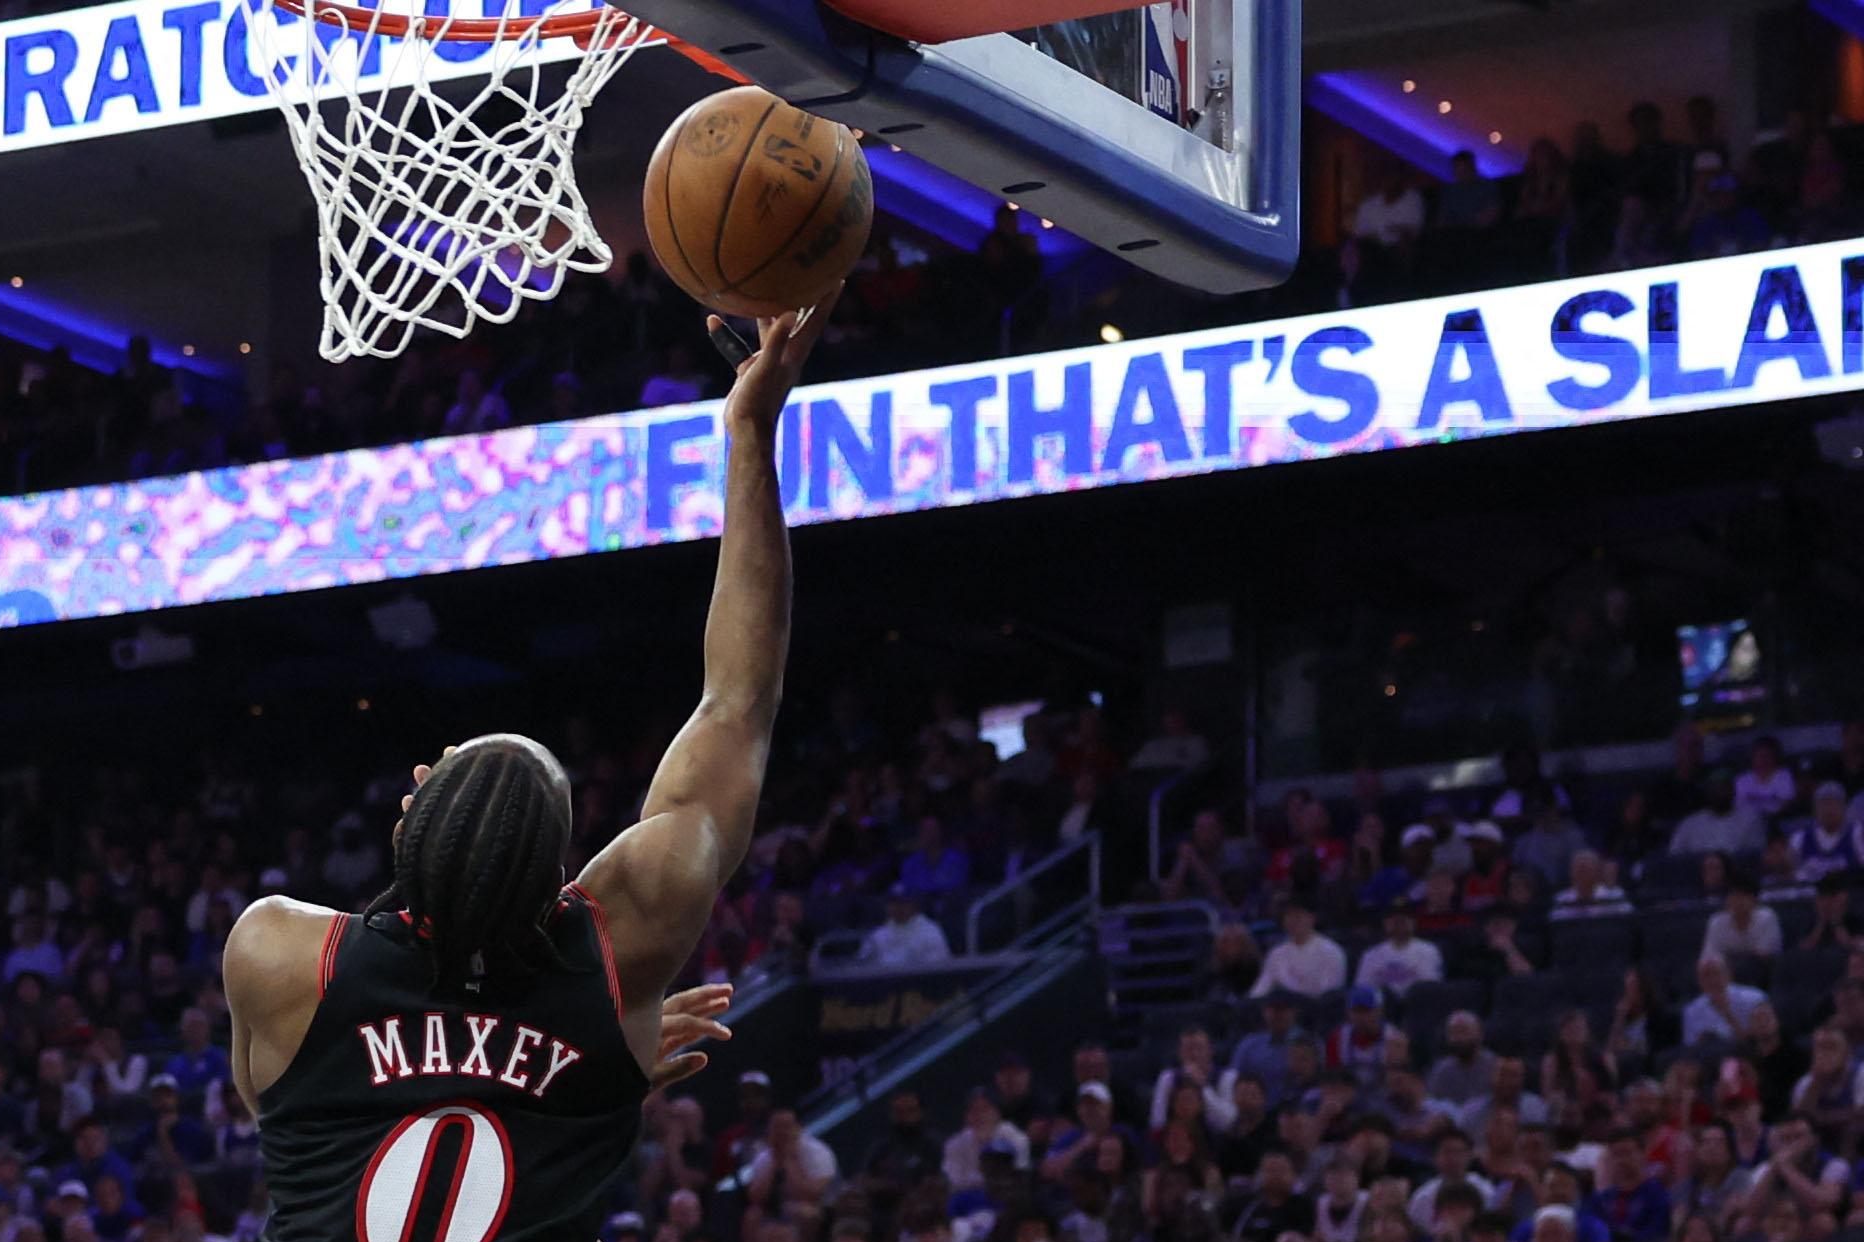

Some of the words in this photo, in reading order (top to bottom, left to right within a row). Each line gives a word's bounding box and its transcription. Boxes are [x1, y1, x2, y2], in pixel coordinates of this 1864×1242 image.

[1149, 69, 1174, 115] NBA
[929, 327, 1382, 493] THAT'S
[1414, 308, 1518, 432] A
[1546, 255, 1864, 412] SLA
[357, 1011, 583, 1097] MAXEY
